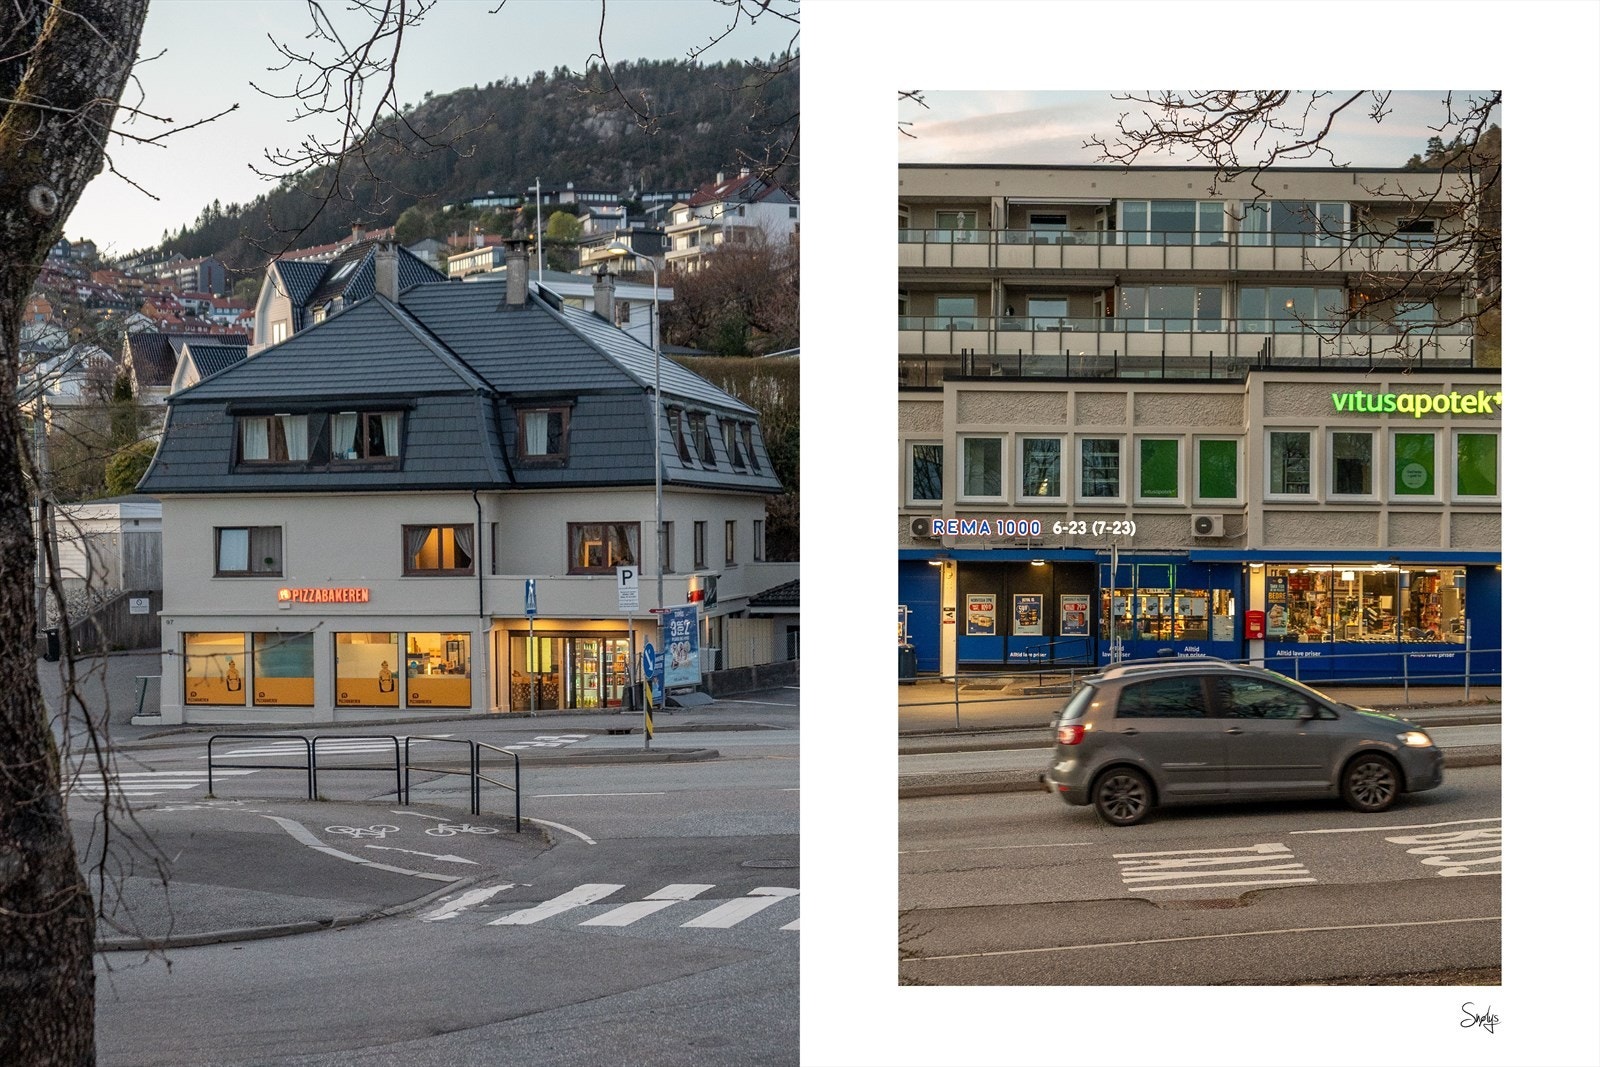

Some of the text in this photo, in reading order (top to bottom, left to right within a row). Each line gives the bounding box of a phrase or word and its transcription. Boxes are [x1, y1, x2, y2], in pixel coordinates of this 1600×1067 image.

[932, 519, 1136, 536] REMA 1000 6-23 (7-23)
[622, 570, 633, 585] P
[292, 588, 369, 602] PIZZABAKEREN
